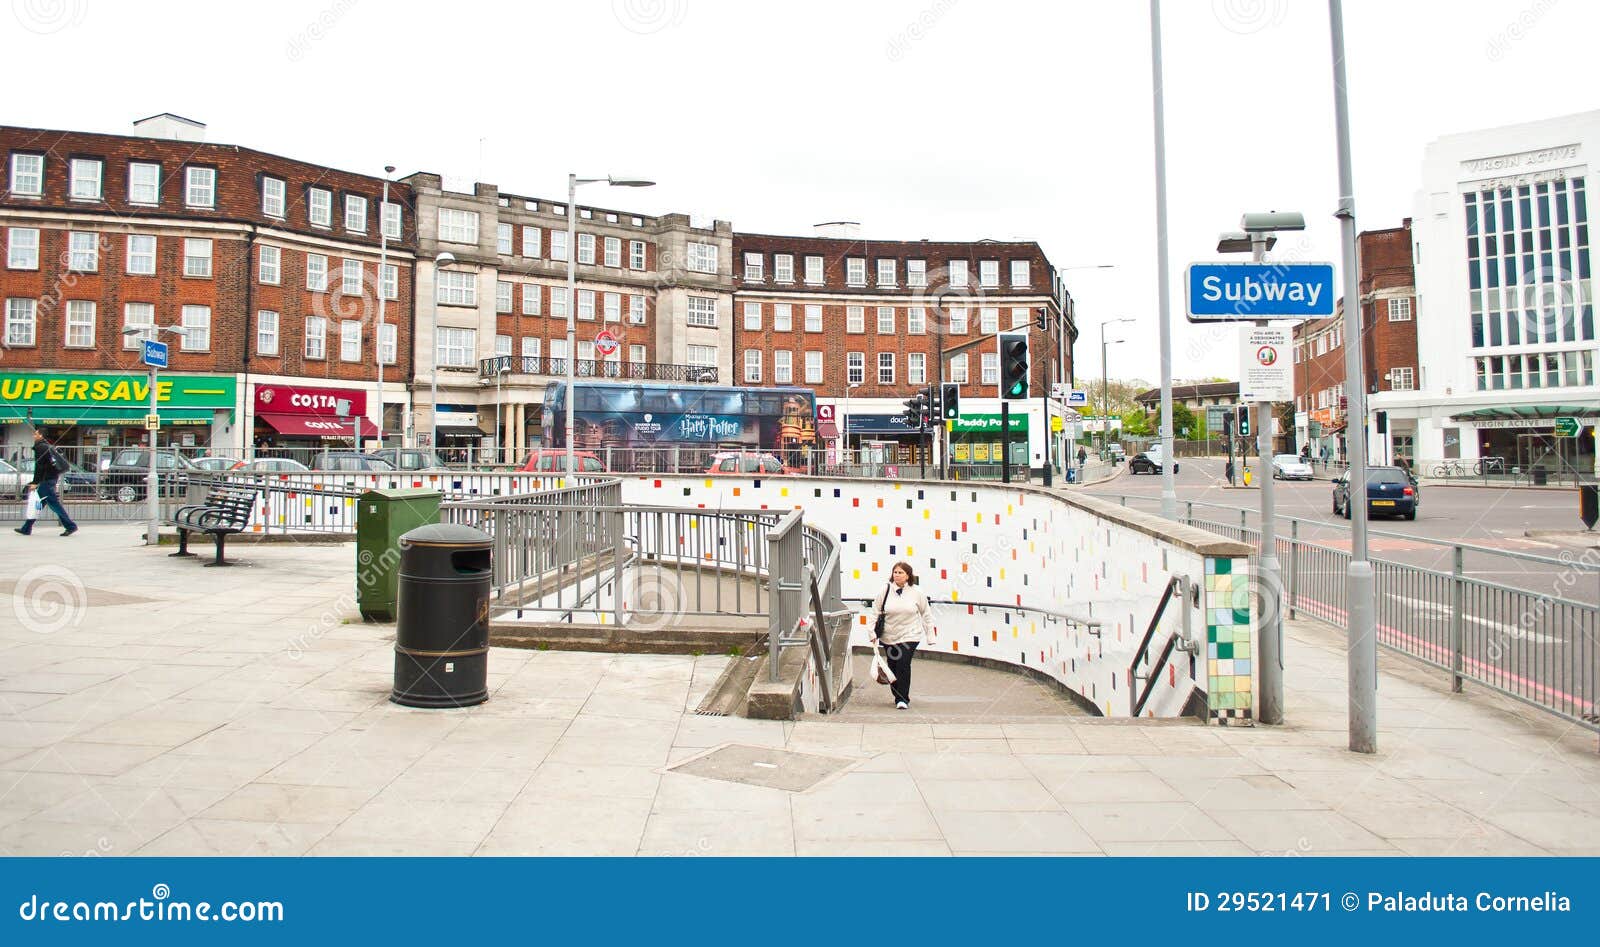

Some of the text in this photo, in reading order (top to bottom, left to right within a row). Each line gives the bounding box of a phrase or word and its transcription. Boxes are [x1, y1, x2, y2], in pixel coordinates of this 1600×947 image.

[1466, 148, 1577, 172] VIRGIN ACTIVE
[1202, 275, 1322, 306] Subway
[147, 345, 166, 362] Subway
[1, 379, 173, 401] UPERSAVE
[291, 394, 337, 408] COSTA
[304, 421, 344, 430] COSTA
[680, 418, 739, 441] Harry Potter
[958, 419, 1020, 427] Paddy Poer
[1472, 420, 1504, 428] VIRGIN
[1509, 419, 1539, 427] ACTIVE
